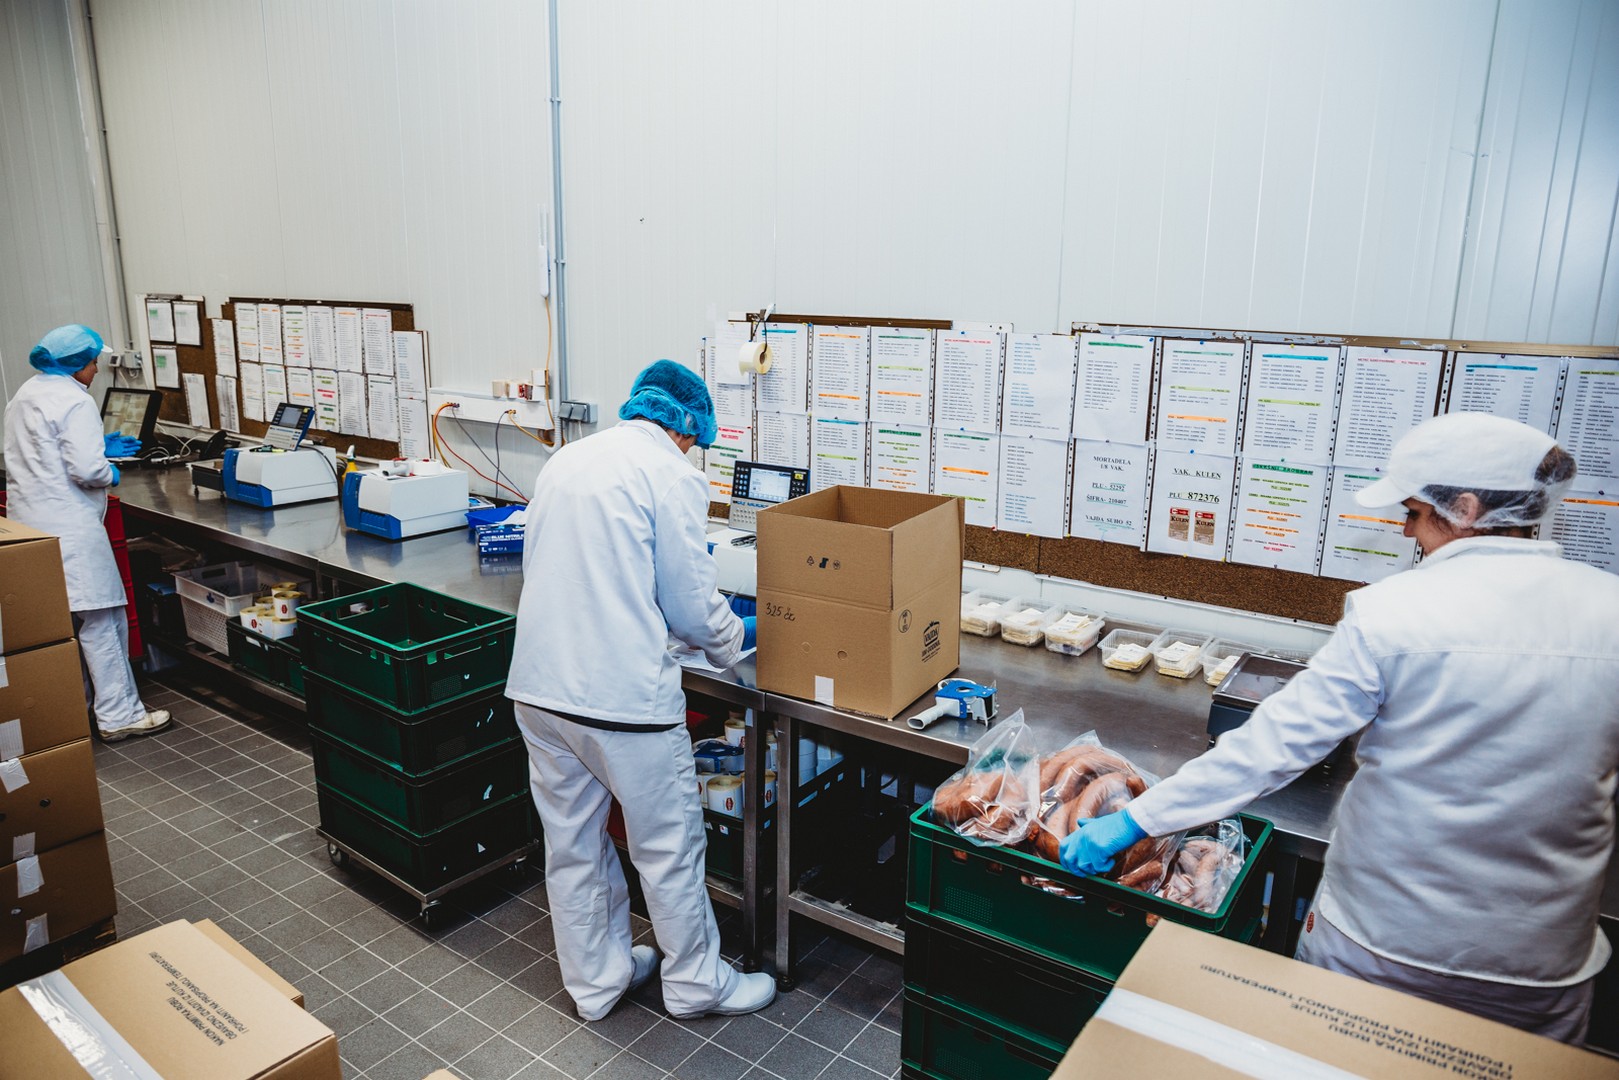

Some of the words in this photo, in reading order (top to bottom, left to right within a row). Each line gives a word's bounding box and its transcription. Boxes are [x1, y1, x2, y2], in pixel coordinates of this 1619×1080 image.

[1093, 456, 1131, 465] MORTADELA
[1196, 470, 1221, 478] KULEN
[1188, 492, 1220, 503] 872376
[766, 602, 783, 616] 325
[166, 980, 186, 996] KUTIJE
[179, 977, 213, 1003] PROPISANOJ
[166, 996, 186, 1011] ROBU
[1291, 1003, 1339, 1023] KUTIJE
[179, 1008, 208, 1030] PRIMITKA
[216, 1007, 247, 1031] POHRANITI
[1298, 996, 1389, 1031] PROPISANOJ
[206, 1015, 237, 1040] OBAVEZNO
[1329, 1024, 1370, 1042] ROBU
[1344, 1020, 1357, 1029] IZ
[1394, 1026, 1414, 1039] NA
[202, 1028, 225, 1046] NAKON
[1360, 1025, 1419, 1050] IZVADITI
[1375, 1040, 1448, 1069] PRIMITKA
[1418, 1034, 1504, 1068] POHRANITI
[1424, 1046, 1513, 1080] OBAVEZNO
